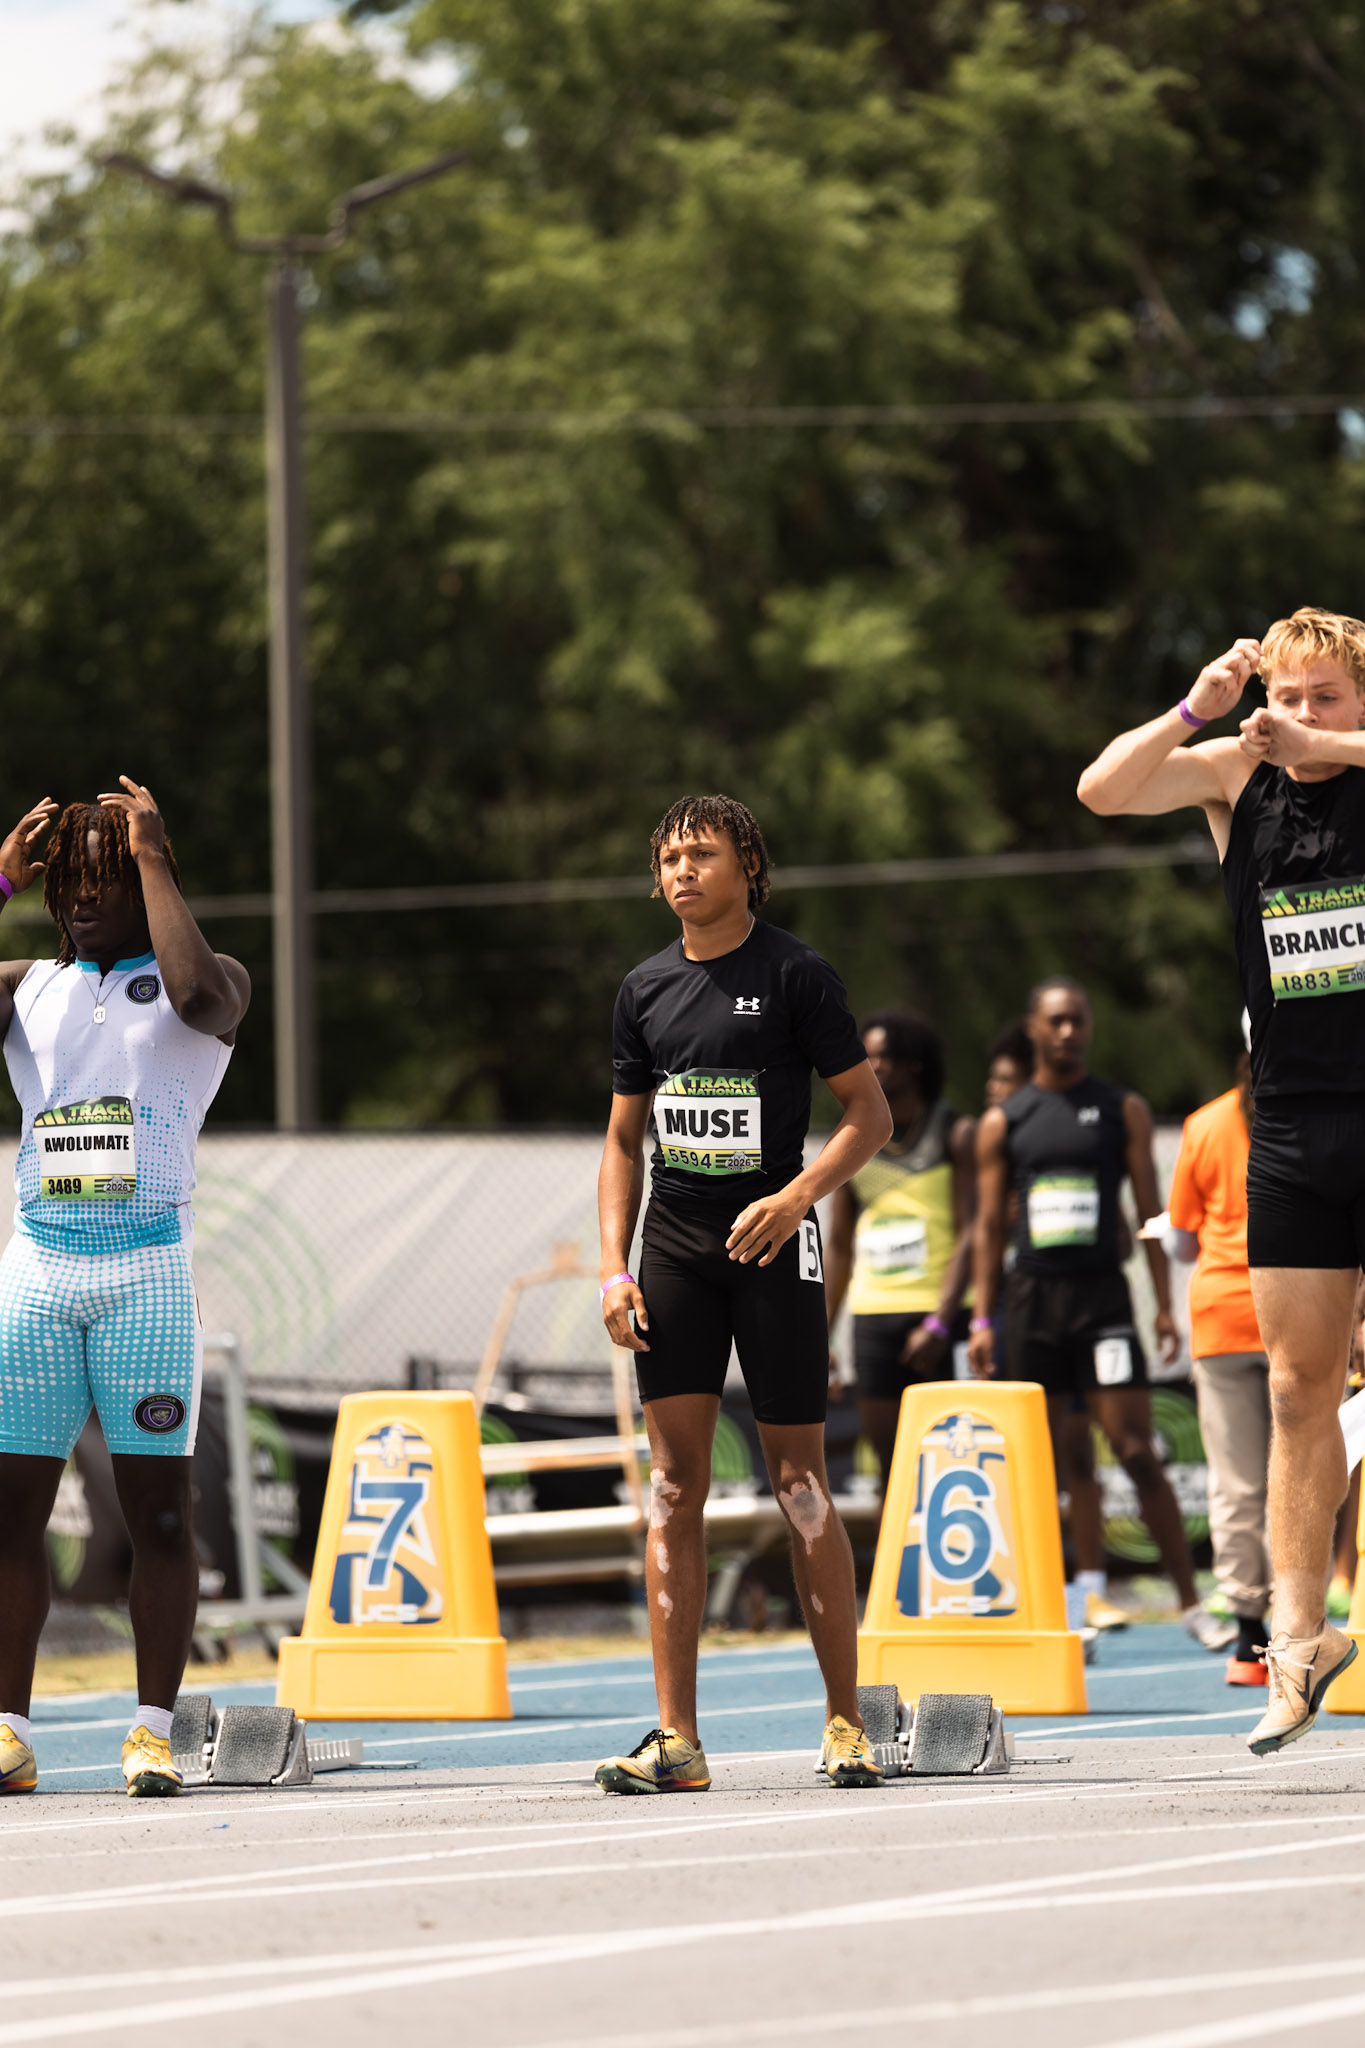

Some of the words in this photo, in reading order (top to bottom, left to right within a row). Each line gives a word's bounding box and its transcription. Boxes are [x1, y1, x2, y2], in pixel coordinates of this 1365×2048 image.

[1295, 884, 1365, 906] TRACK
[1281, 971, 1331, 992] 1883
[687, 1076, 756, 1089] TRACK
[687, 1088, 757, 1096] NATIONALS
[68, 1102, 132, 1118] TRACK
[67, 1114, 132, 1125] NATIONALS
[664, 1108, 749, 1138] MUSE
[44, 1135, 130, 1152] AWOLUMATE
[668, 1148, 712, 1169] 5594
[728, 1158, 751, 1167] 2026
[48, 1178, 82, 1195] 3489
[106, 1183, 128, 1192] 2026
[805, 1226, 819, 1278] 5
[924, 1467, 993, 1583] 6
[358, 1479, 426, 1589] 7
